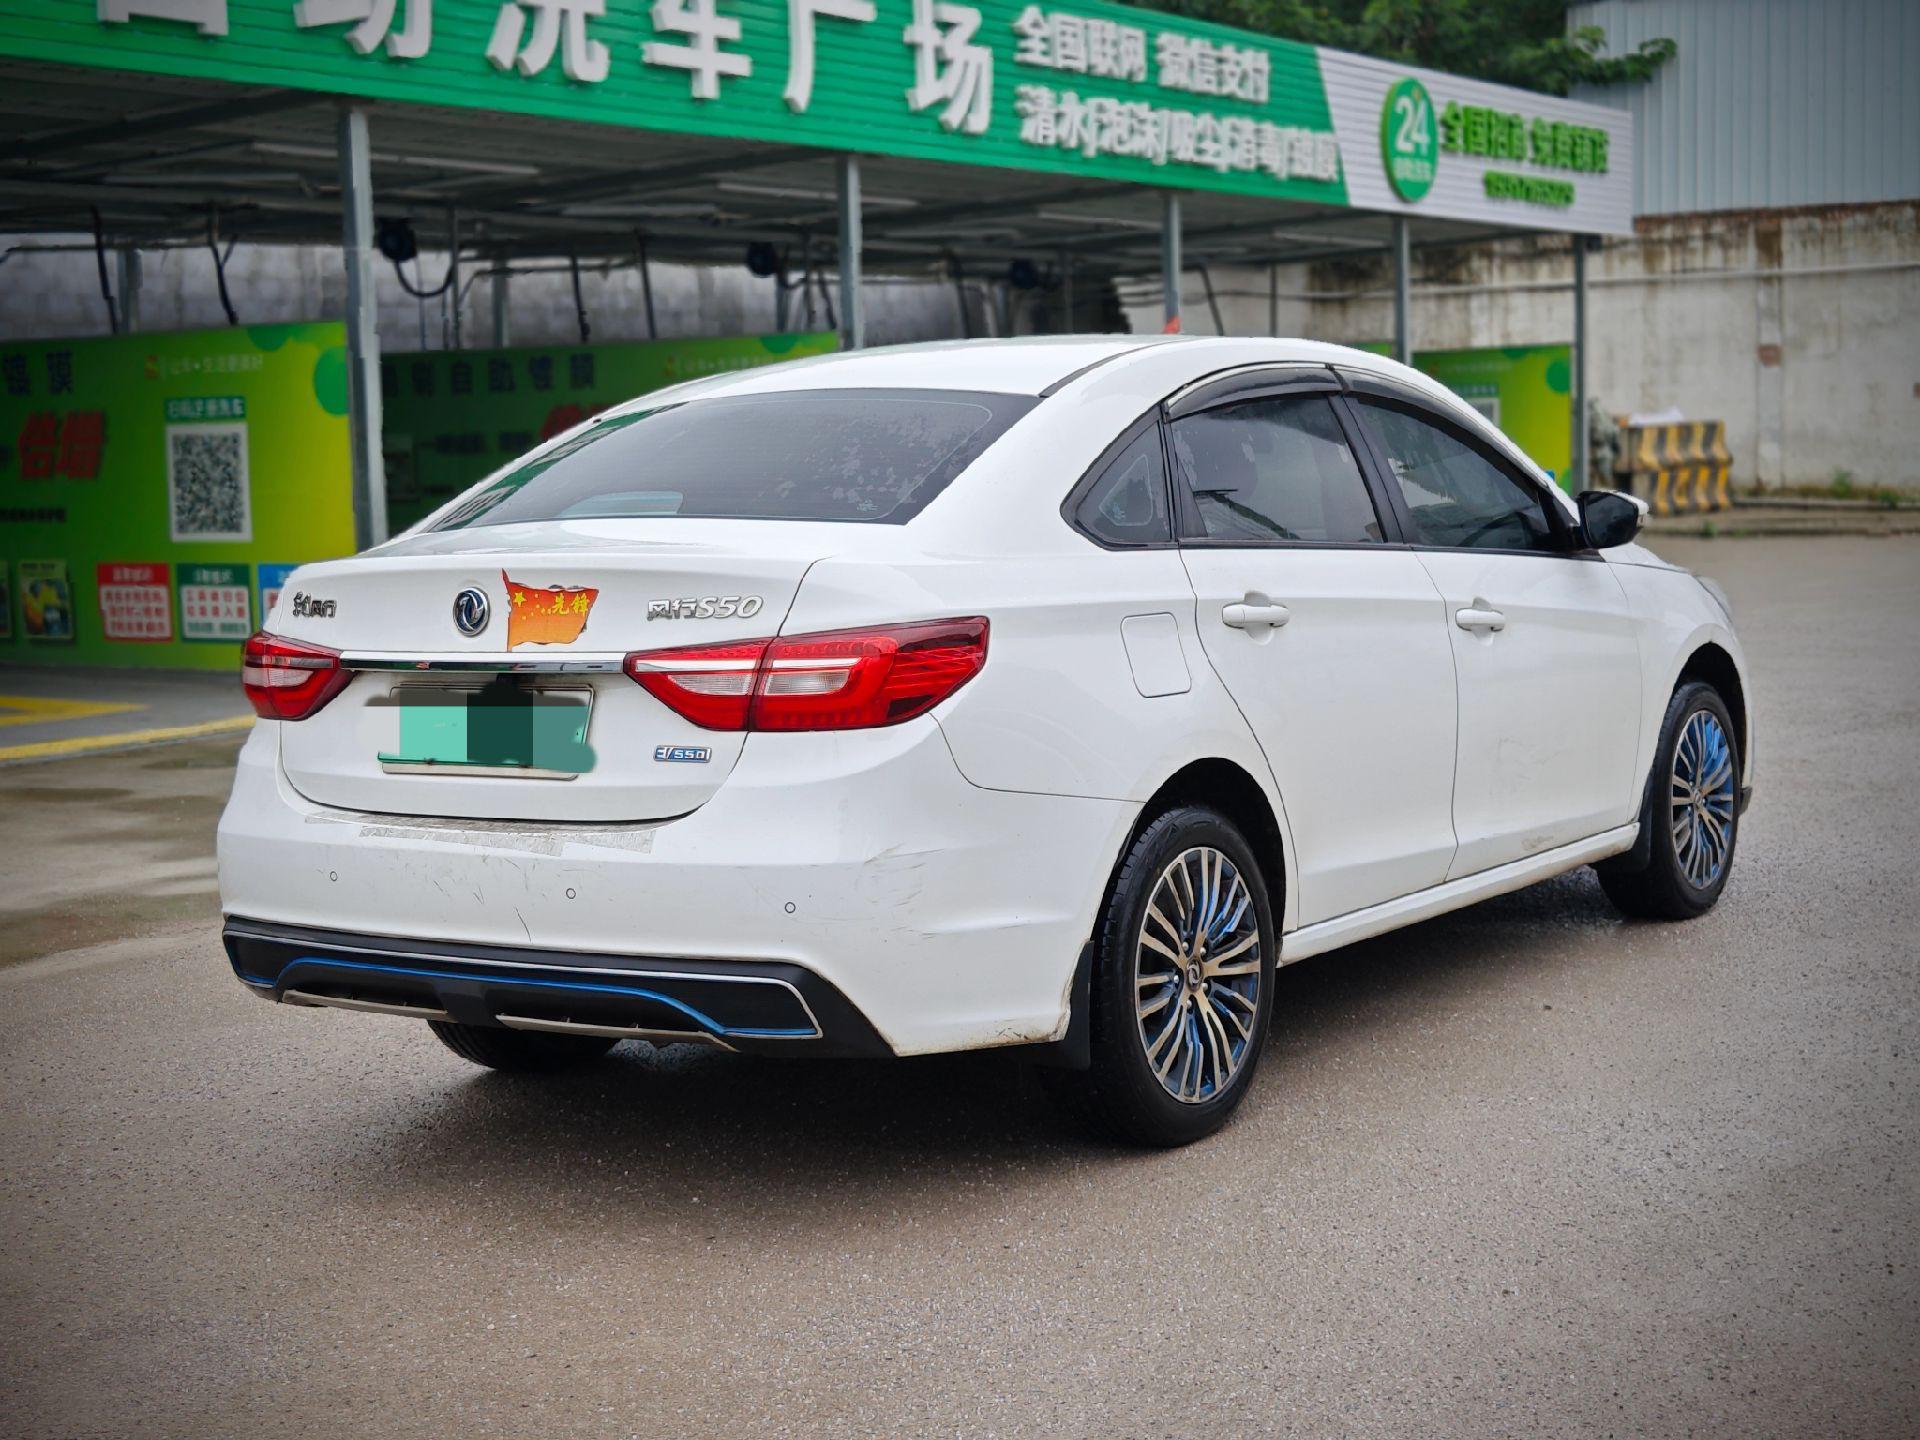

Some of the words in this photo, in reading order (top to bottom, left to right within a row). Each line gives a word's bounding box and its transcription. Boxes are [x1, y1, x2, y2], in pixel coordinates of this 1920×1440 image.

[97, 0, 993, 134] 洗车广场
[1013, 6, 1147, 82] 全国联网
[1395, 97, 1431, 155] 24
